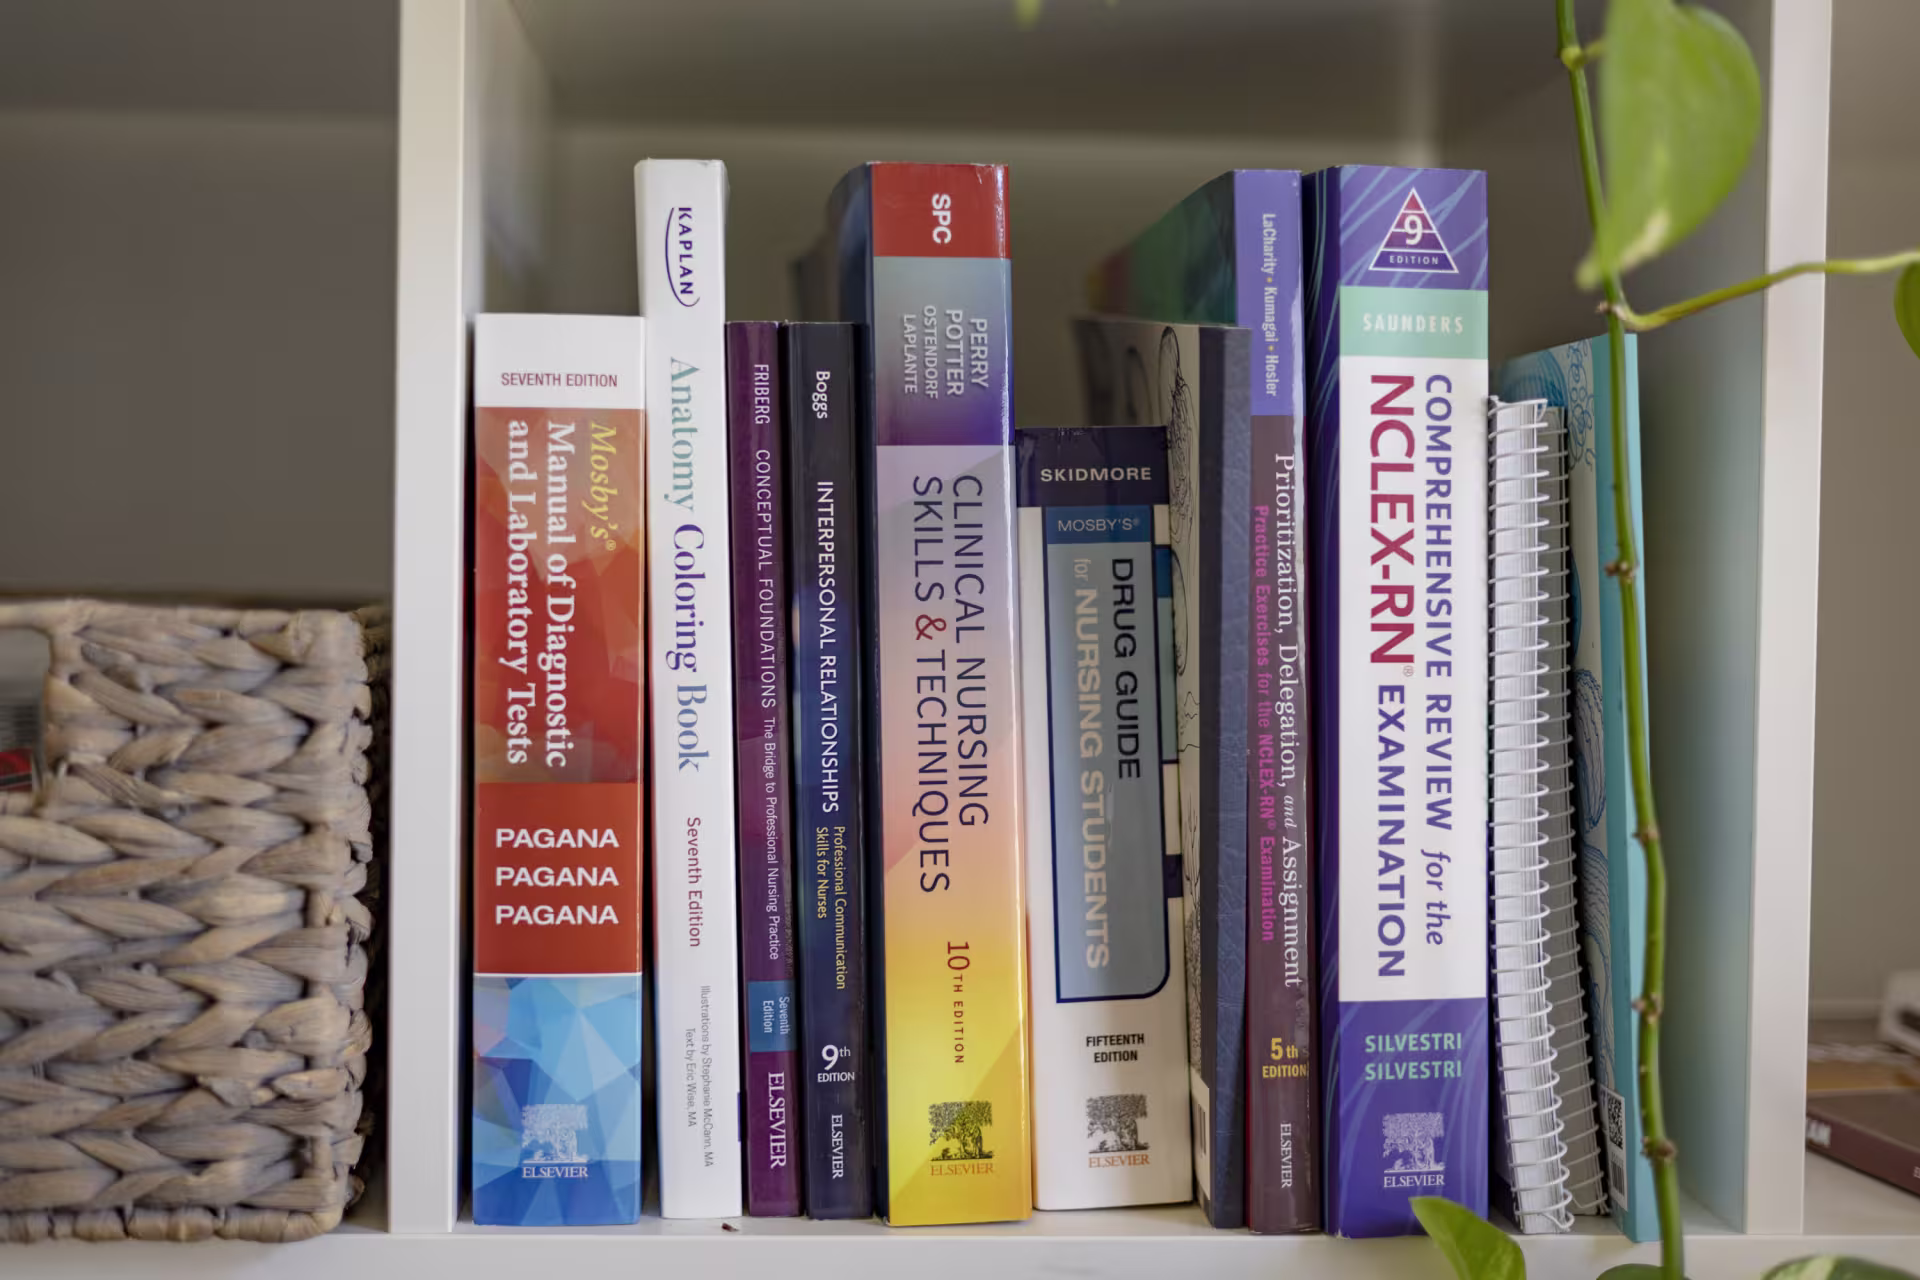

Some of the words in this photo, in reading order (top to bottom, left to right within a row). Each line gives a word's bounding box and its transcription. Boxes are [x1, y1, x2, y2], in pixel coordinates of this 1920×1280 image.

[931, 193, 952, 244] SPC
[1261, 213, 1277, 275] LaCharity
[1403, 215, 1423, 245] 9
[677, 207, 694, 295] KAPLAN
[1389, 255, 1439, 265] EDITION
[1262, 286, 1279, 343] Kumagai
[1363, 313, 1464, 334] SAUNDERS
[904, 314, 918, 394] LAPLANTE
[924, 305, 938, 399] OSTENDORF
[945, 309, 964, 397] POTTER
[970, 318, 989, 388] PERRY
[1265, 355, 1279, 397] Hosler
[501, 371, 561, 387] SEVENTH
[565, 372, 618, 388] EDITION
[754, 364, 771, 424] FRIBERG
[812, 370, 830, 419] Boggs
[507, 420, 538, 481] and
[663, 357, 701, 512] Anatomy
[546, 420, 577, 544] Manual
[1040, 467, 1153, 482] SKIDMORE
[755, 449, 773, 571] CONCEPTUAL
[1425, 374, 1452, 678] COMPREHENSIVE
[913, 475, 944, 602] SKILLS
[952, 475, 985, 644] CLINICAL
[1254, 505, 1272, 578] Practice
[1274, 454, 1298, 634] Prioritization,
[498, 491, 538, 675] Laboratory
[547, 565, 577, 589] of
[817, 481, 836, 650] INTERPERSONAL
[1073, 557, 1092, 582] for
[665, 523, 705, 673] Coloring
[1112, 558, 1137, 658] DRUG
[758, 579, 776, 708] FOUNDATIONS
[915, 614, 947, 641] &
[1256, 584, 1272, 667] Exercises
[537, 595, 577, 768] Diagnostic
[1075, 588, 1104, 759] NURSING
[1257, 671, 1273, 694] for
[507, 682, 537, 766] Tests
[676, 684, 709, 772] Book
[764, 717, 775, 739] The
[820, 655, 839, 813] RELATIONSHIPS
[1115, 671, 1141, 779] GUIDE
[1258, 697, 1273, 728] the
[1275, 644, 1300, 788] Delegation,
[763, 742, 777, 779] Bridge
[956, 657, 989, 826] NURSING
[1426, 694, 1452, 831] REVIEW
[765, 782, 775, 793] to
[912, 649, 950, 893] TECHNIQUES
[766, 797, 779, 864] Professional
[1283, 795, 1297, 829] and
[1377, 684, 1405, 977] EXAMINATION
[495, 828, 620, 849] PAGANA
[686, 816, 702, 885] Seventh
[816, 827, 830, 857] Skills
[834, 826, 847, 895] Professional
[495, 866, 620, 887] PAGANA
[766, 867, 779, 913] Nursing
[817, 859, 830, 876] for
[1081, 770, 1110, 969] STUDENTS
[1260, 836, 1277, 941] Examination
[1421, 849, 1451, 891] for
[495, 905, 620, 925] PAGANA
[688, 890, 704, 947] Edition
[817, 879, 830, 919] Nurses
[1278, 836, 1302, 988] Assignment
[1426, 900, 1451, 945] the
[769, 915, 781, 960] Practice
[834, 898, 848, 990] Communication
[685, 1028, 696, 1047] Text
[700, 985, 711, 1042] Illustrations
[763, 1000, 774, 1033] Edition
[779, 996, 790, 1035] Seventh
[953, 1000, 964, 1063] EDITION
[684, 1049, 697, 1062] by
[701, 1043, 712, 1056] by
[821, 1045, 851, 1070] 9th
[1086, 1033, 1145, 1047] FIFTEENTH
[1093, 1049, 1138, 1063] EDITION
[1271, 1038, 1299, 1060] 5th
[1365, 1033, 1462, 1053] SILVESTRI
[686, 1063, 697, 1081] Eric
[701, 1057, 712, 1107] Stephanie
[817, 1071, 855, 1083] EDITION
[1262, 1063, 1308, 1078] EDITION
[1365, 1060, 1462, 1081] SILVESTRI
[687, 1111, 697, 1127] MA
[768, 1071, 787, 1169] ELSEVIER
[522, 1165, 589, 1178] ELSEVIER
[704, 1151, 714, 1167] MA
[831, 1114, 844, 1179] ELSEVIER
[930, 1162, 994, 1176] ELSEVIER
[1088, 1154, 1150, 1168] ELSEVIER
[1280, 1123, 1293, 1189] ELSEVIER
[1383, 1174, 1445, 1188] ELSEVIER
